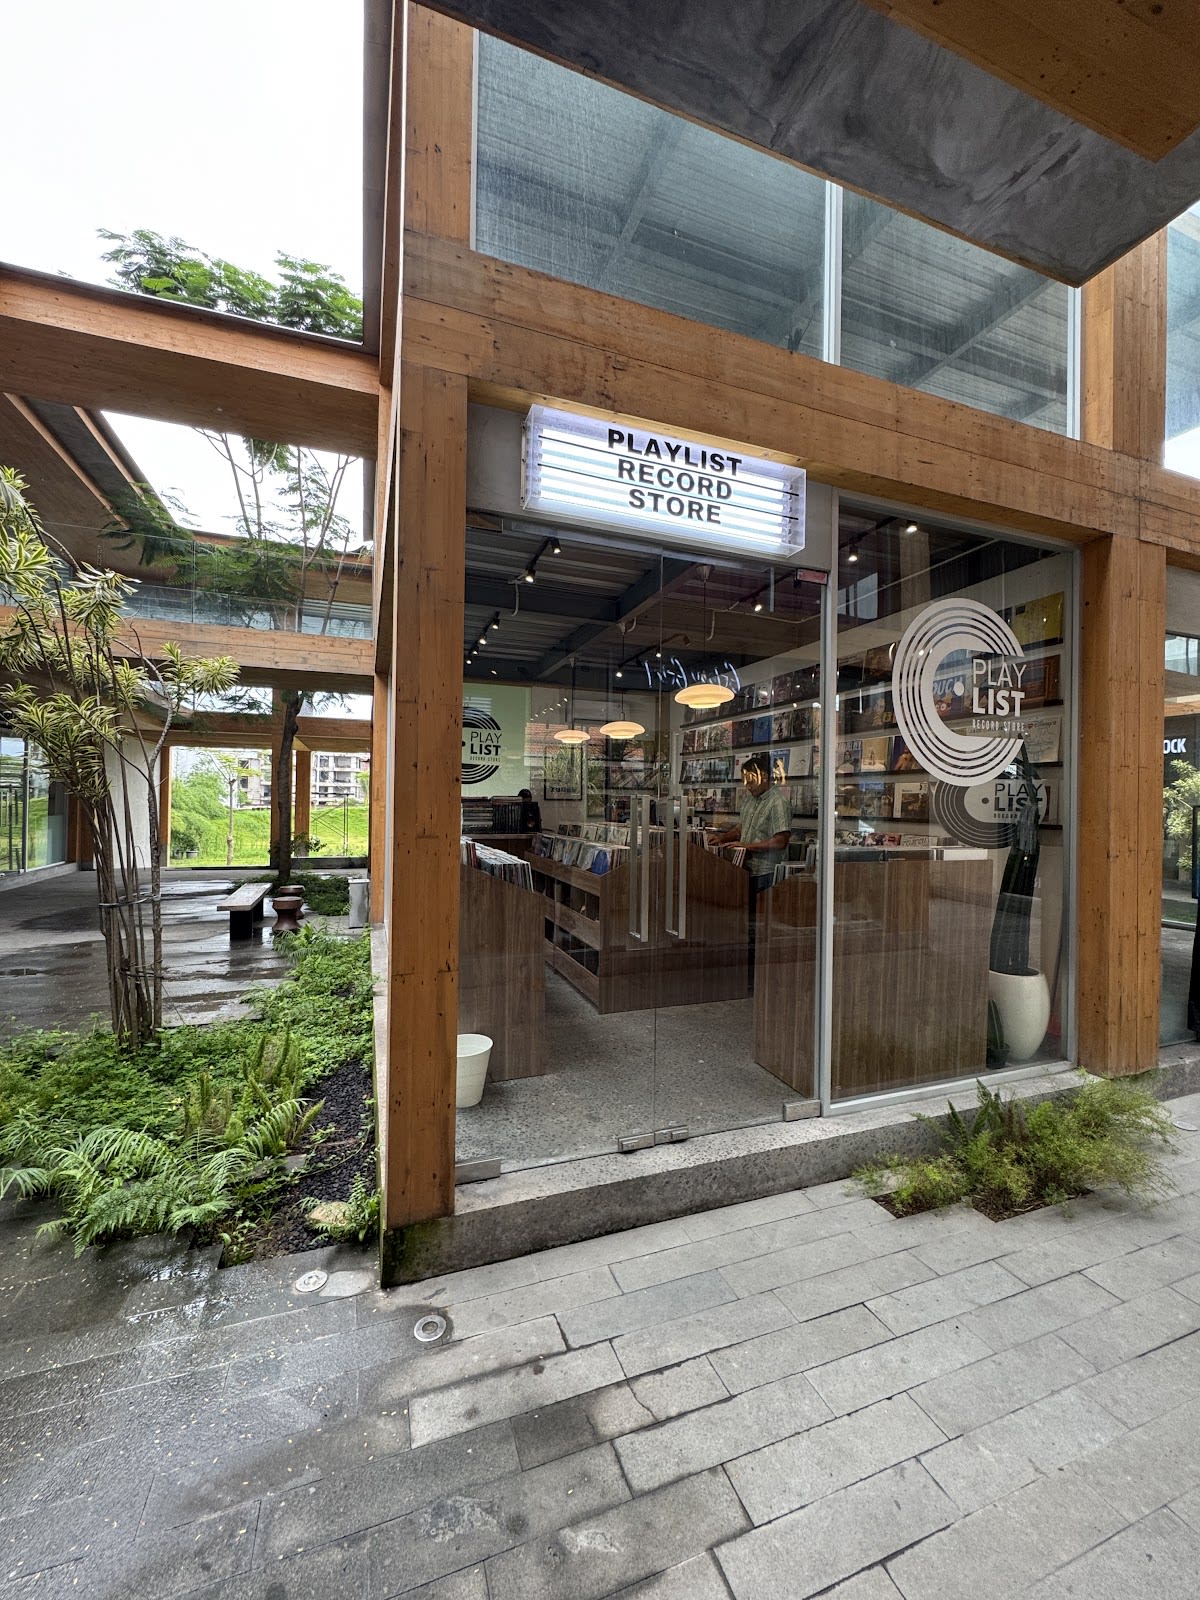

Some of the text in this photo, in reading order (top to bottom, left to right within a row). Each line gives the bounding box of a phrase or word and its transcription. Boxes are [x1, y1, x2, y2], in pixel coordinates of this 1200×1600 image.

[608, 428, 742, 476] PLAYLIST
[618, 458, 732, 500] RECORD
[629, 488, 721, 524] STORE
[973, 659, 1027, 688] PLAY
[972, 687, 1025, 717] LIST
[470, 731, 502, 744] PLAY
[972, 719, 999, 732] RECORD
[470, 743, 501, 756] LIST
[994, 783, 1043, 797] PLAY
